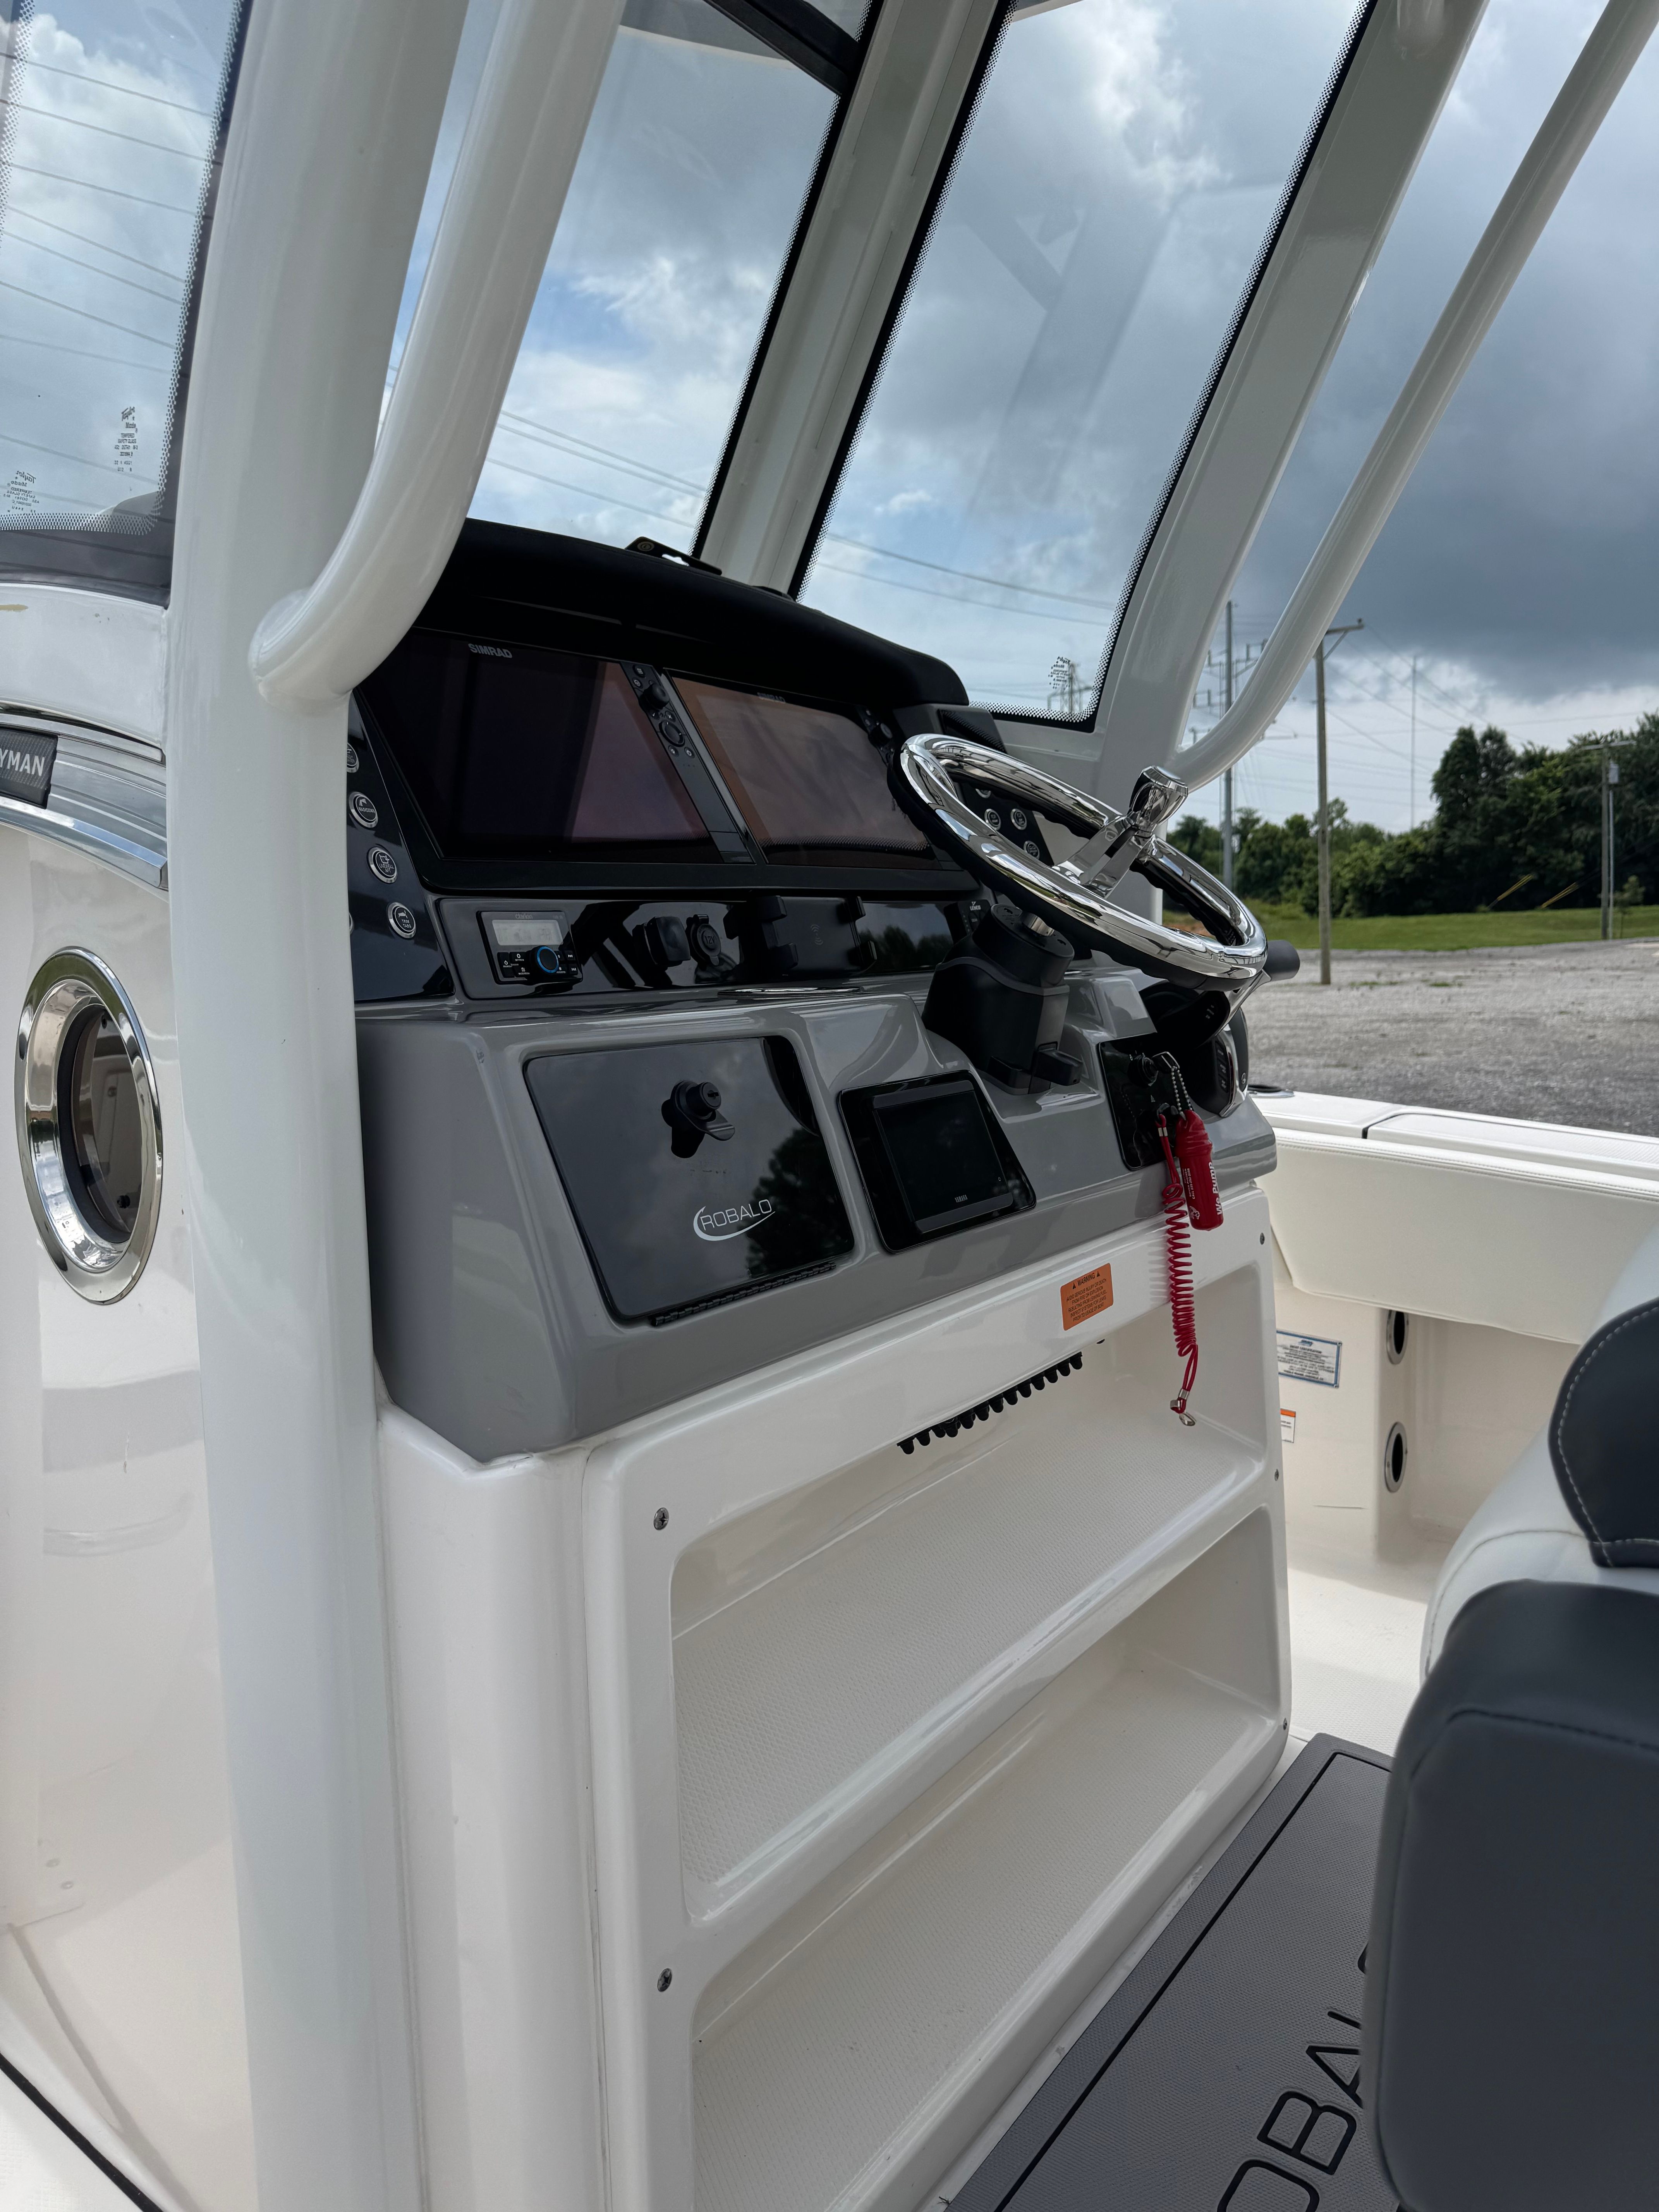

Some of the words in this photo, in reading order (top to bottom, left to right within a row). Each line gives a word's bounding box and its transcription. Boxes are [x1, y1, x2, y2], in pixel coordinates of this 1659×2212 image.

[468, 643, 513, 658] SIMRAD
[0, 748, 45, 776] YMAN
[704, 936, 715, 944] 12V
[1209, 1162, 1219, 1194] Pump
[700, 1199, 772, 1231] ROBALO
[1077, 1273, 1095, 1286] WARNING
[1218, 1943, 1368, 2212] OBA
